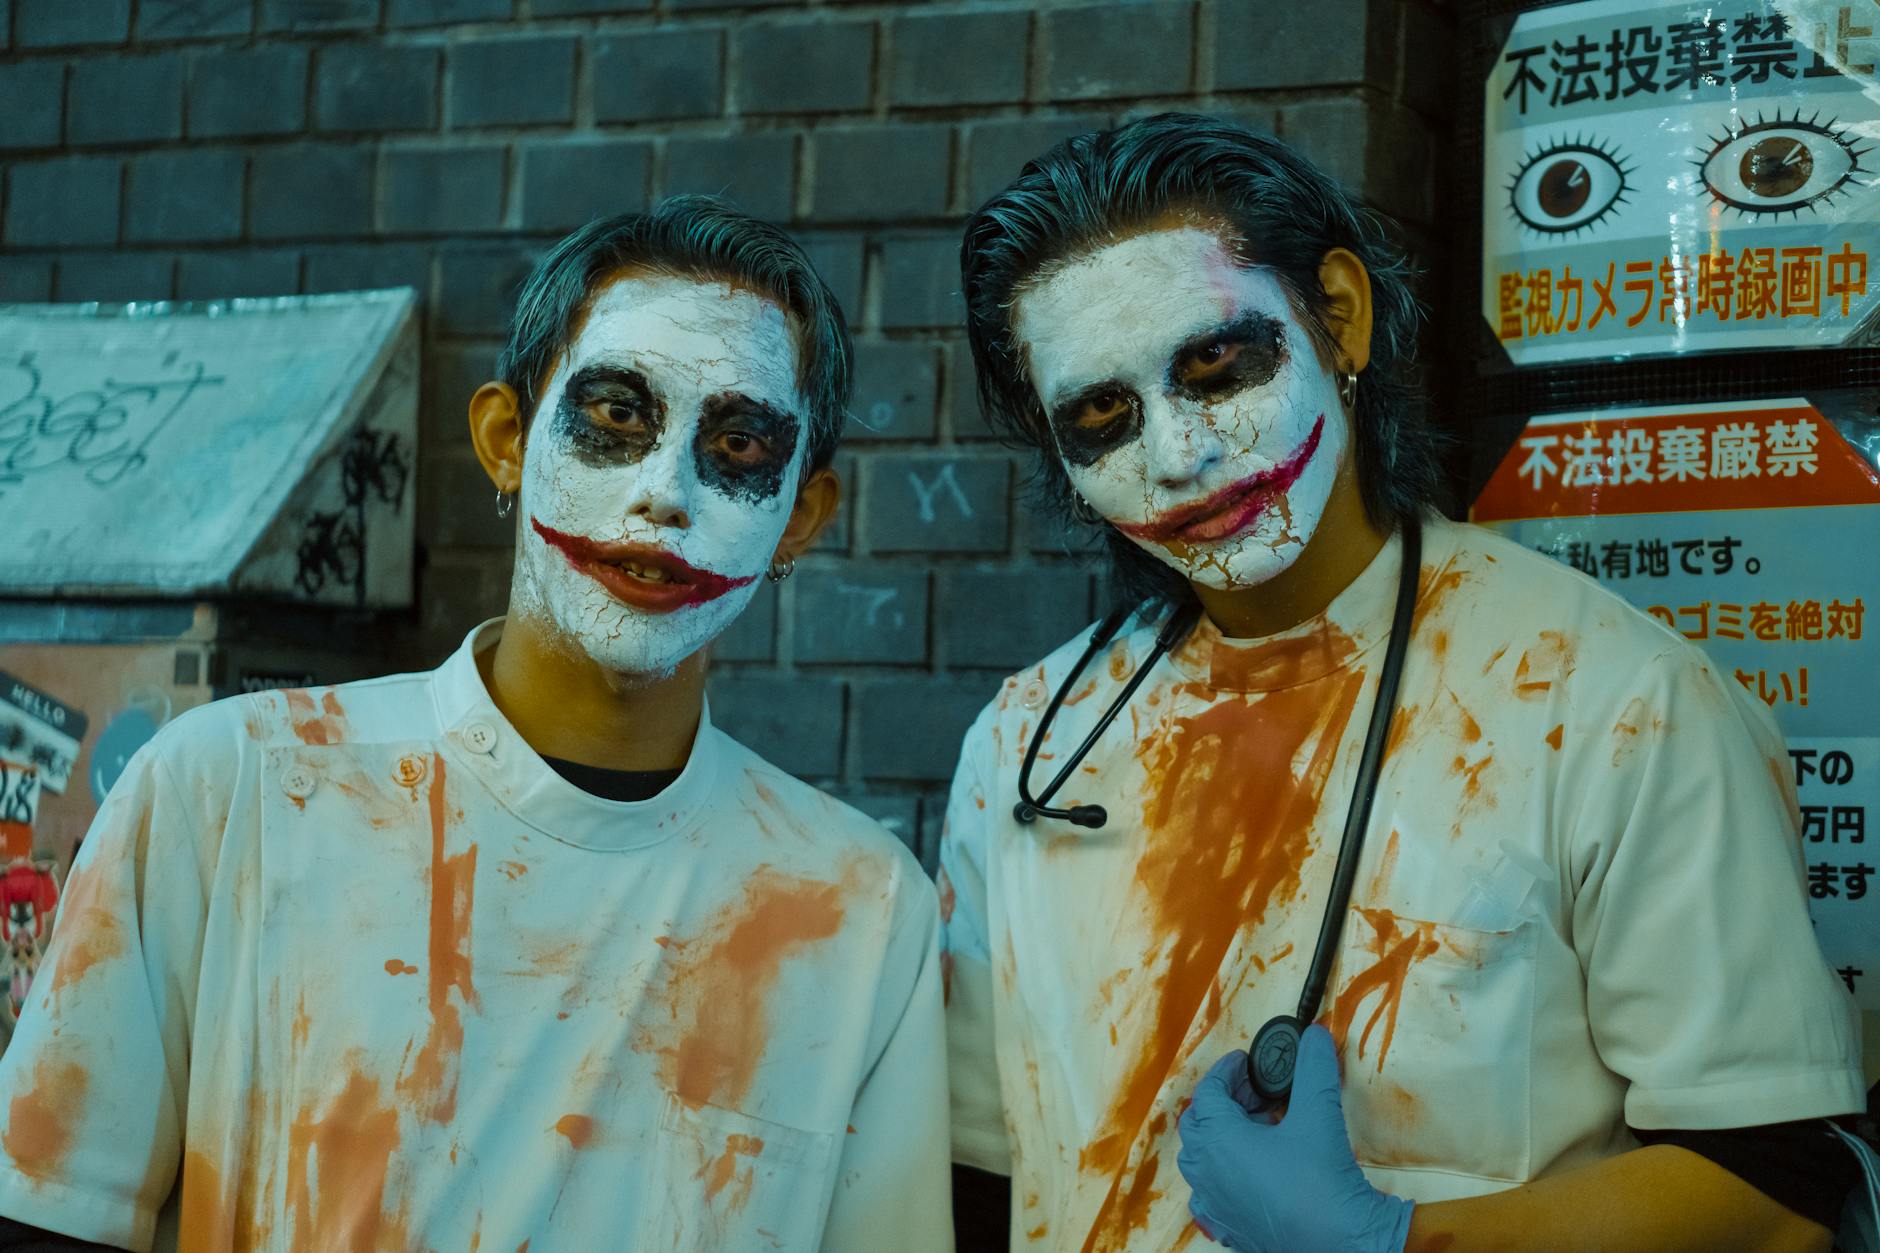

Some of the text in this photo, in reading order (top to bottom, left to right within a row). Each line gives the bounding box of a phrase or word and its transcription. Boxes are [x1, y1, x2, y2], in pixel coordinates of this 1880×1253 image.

[1502, 6, 1876, 115] 不法投棄禁止
[1499, 242, 1868, 341] 監視カメラ常時録画中
[1517, 417, 1820, 491] 不法投棄厳禁
[1536, 536, 1761, 580] 私有地です。
[11, 683, 66, 725] HELLO
[1788, 749, 1854, 786] 下の
[1800, 806, 1866, 844] 万円
[1808, 861, 1876, 900] ます
